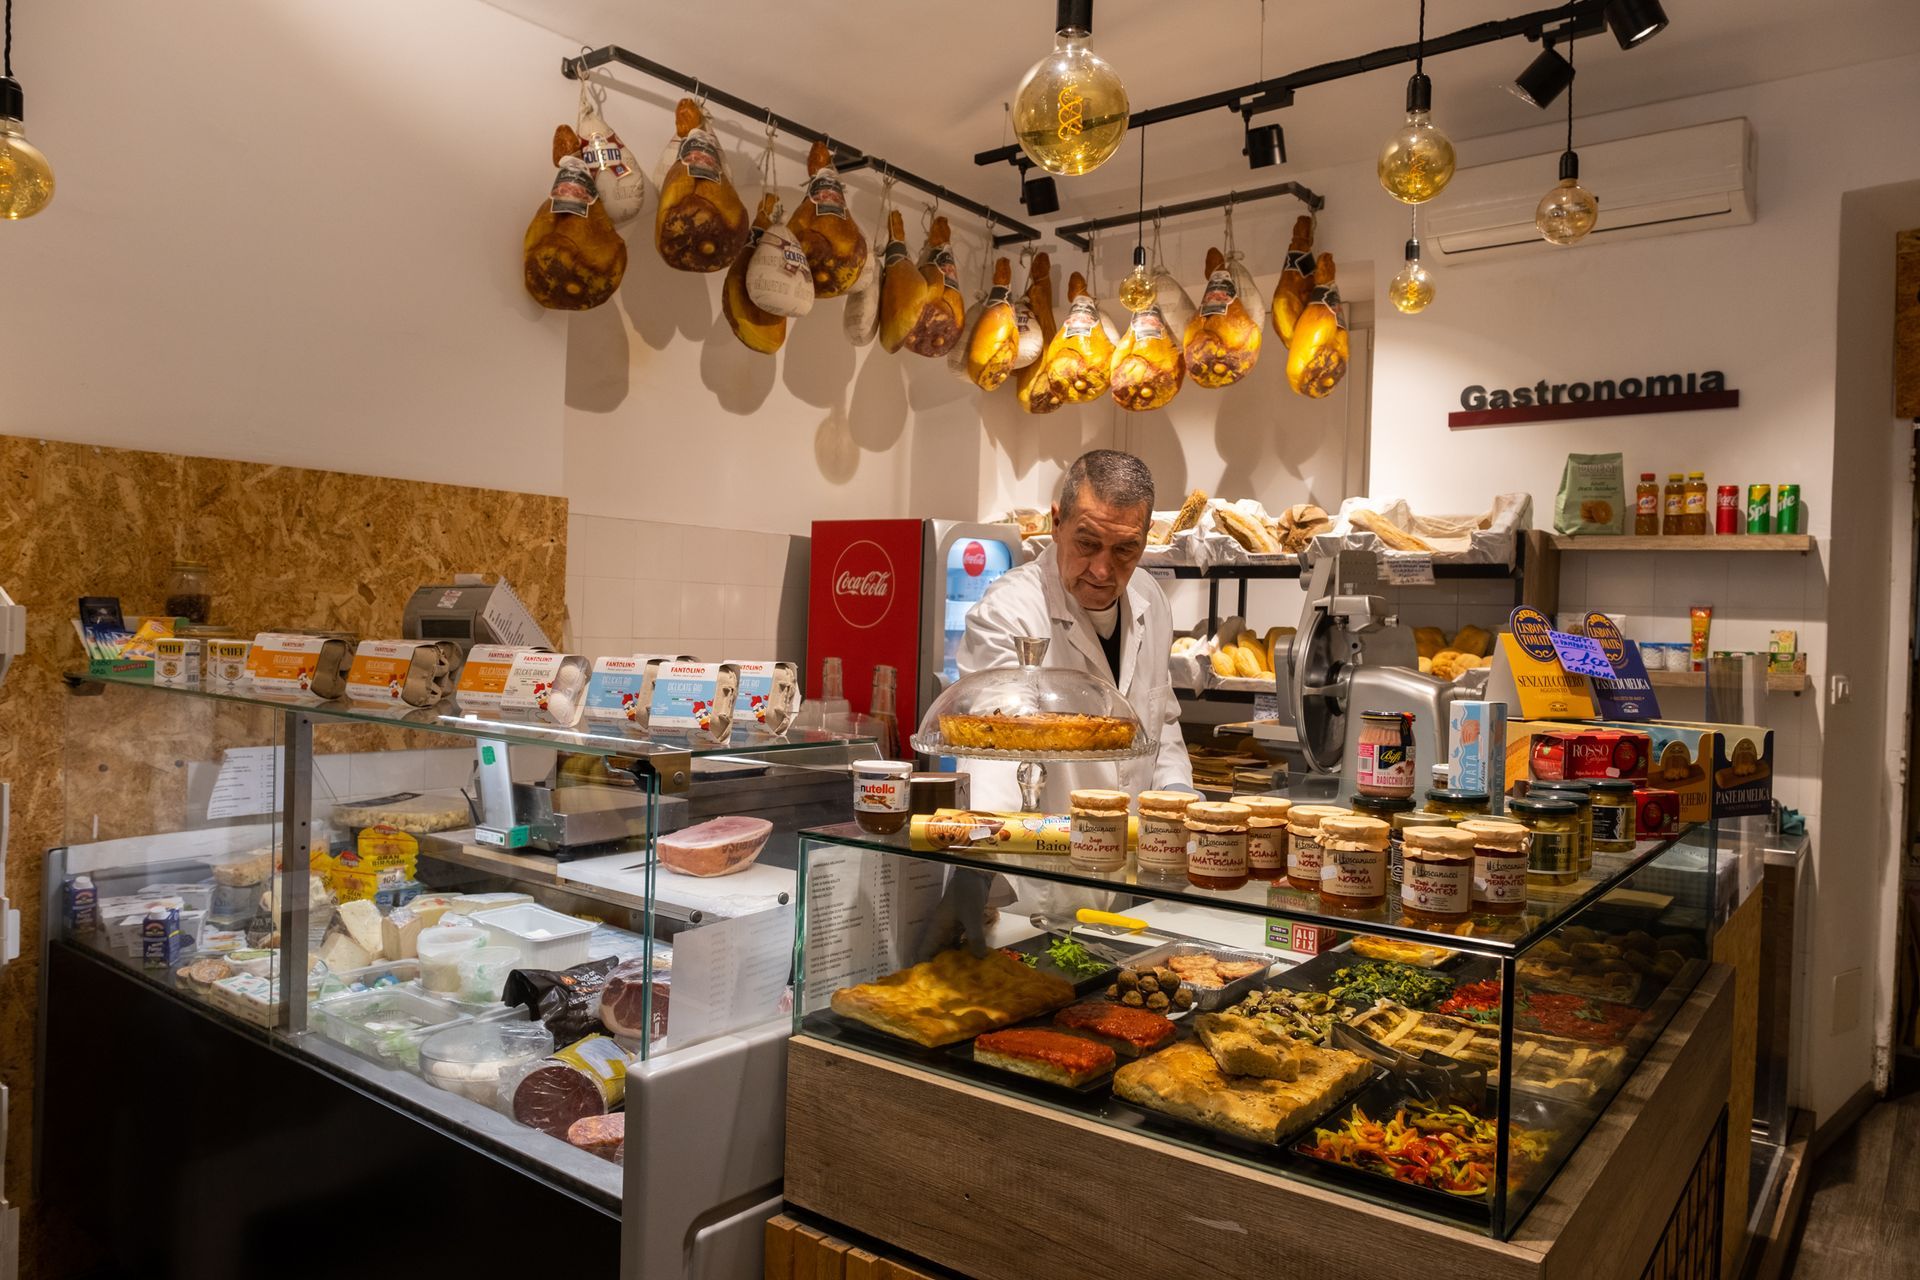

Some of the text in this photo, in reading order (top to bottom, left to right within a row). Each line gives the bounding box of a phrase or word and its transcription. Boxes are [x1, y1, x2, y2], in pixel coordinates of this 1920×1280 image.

[582, 148, 621, 164] GOLETTA
[1460, 370, 1725, 412] Gastronomia
[835, 570, 891, 597] Coca-Cola
[1520, 634, 1552, 646] TOMATI
[158, 644, 182, 654] CHEF
[220, 647, 245, 656] CHEF
[488, 651, 513, 659] FANTOLINO
[523, 655, 552, 663] FANTOLINO
[605, 661, 636, 669] FANTOLINO
[671, 666, 706, 674] FANTOLINO
[1517, 675, 1584, 688] SENZA ZUCCHERO
[1572, 744, 1609, 758] ROSSO
[1376, 775, 1403, 785] RADICCHIO
[860, 784, 895, 794] nutella
[1715, 791, 1736, 805] PASTE
[1745, 788, 1770, 802] MELIGA
[1098, 843, 1120, 852] PEPE
[1296, 928, 1314, 941] ALU
[1296, 939, 1313, 950] FIX
